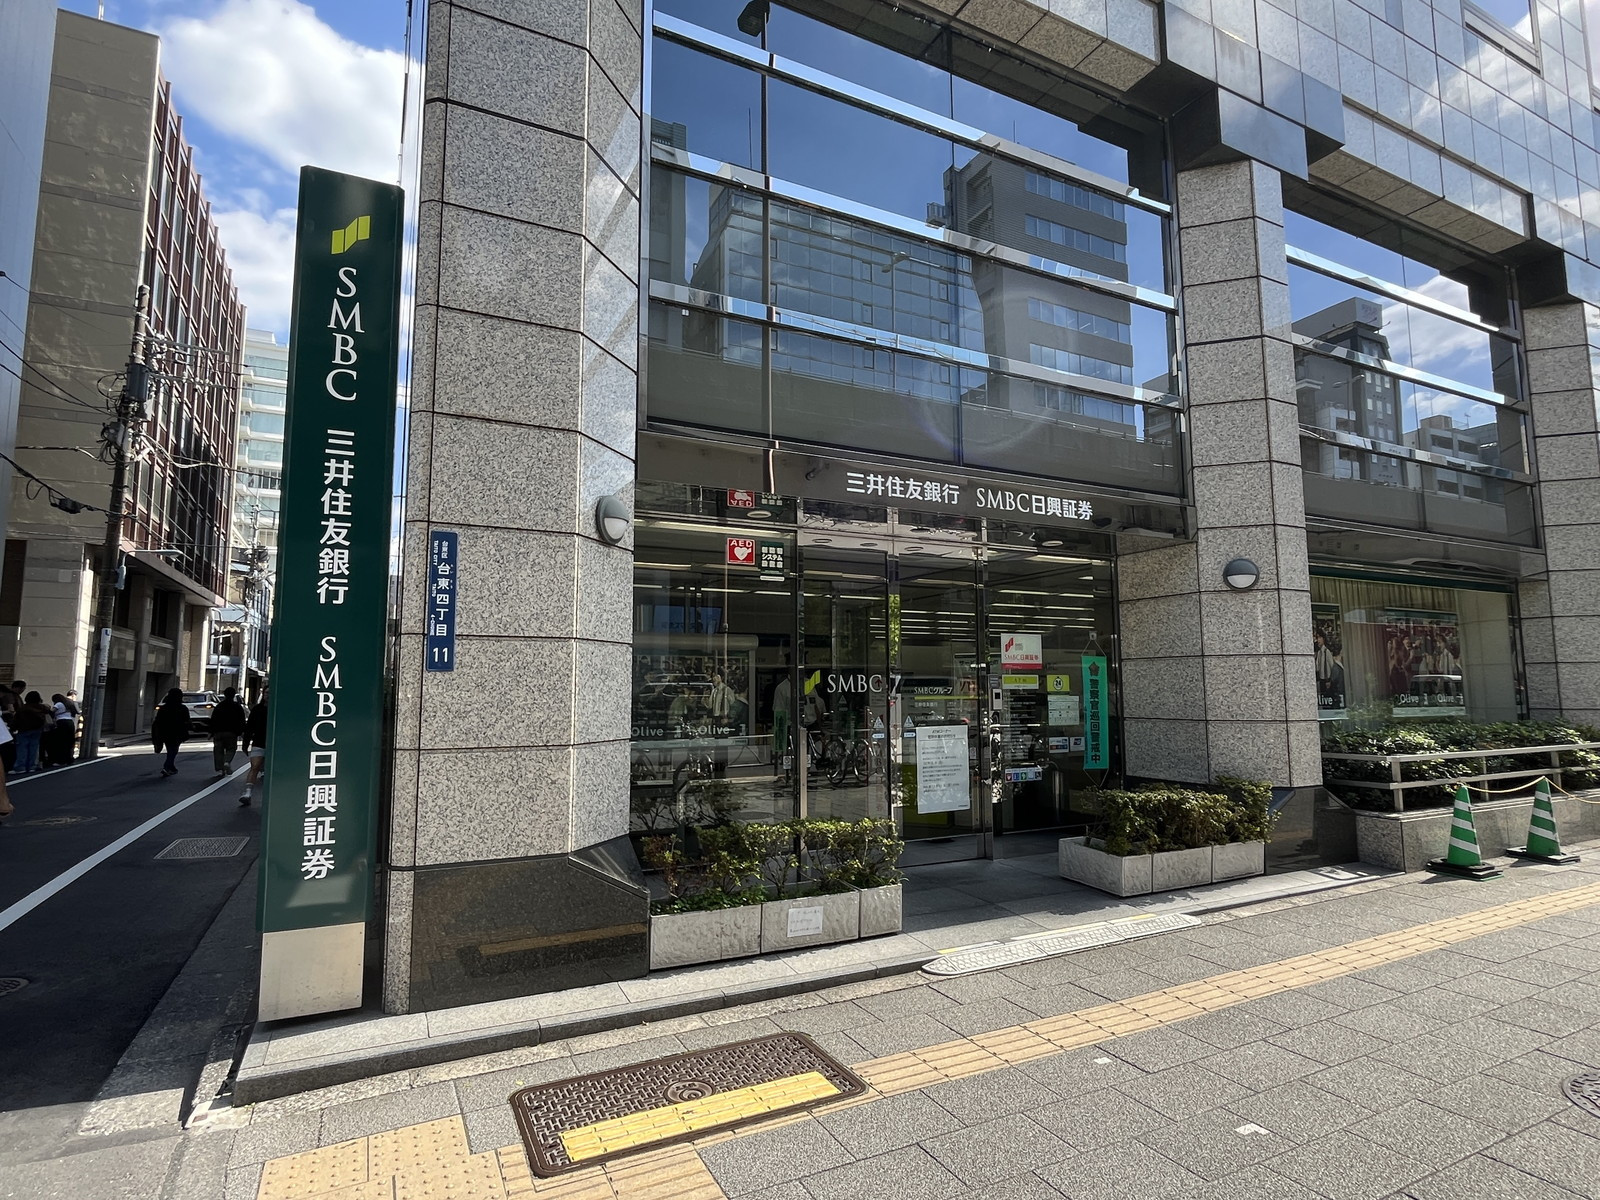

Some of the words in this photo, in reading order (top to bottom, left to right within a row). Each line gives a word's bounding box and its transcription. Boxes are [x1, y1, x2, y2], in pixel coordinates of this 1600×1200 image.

[325, 267, 365, 401] SMBC
[316, 429, 355, 605] 三井住友銀行
[847, 472, 960, 505] 三井住友銀行
[976, 487, 1093, 521] SMBC日興証券
[730, 539, 753, 548] AED
[436, 562, 450, 636] 台東四丁目
[433, 647, 448, 663] 11
[827, 674, 883, 693] SMBC
[301, 636, 342, 880] SMBC日興証券
